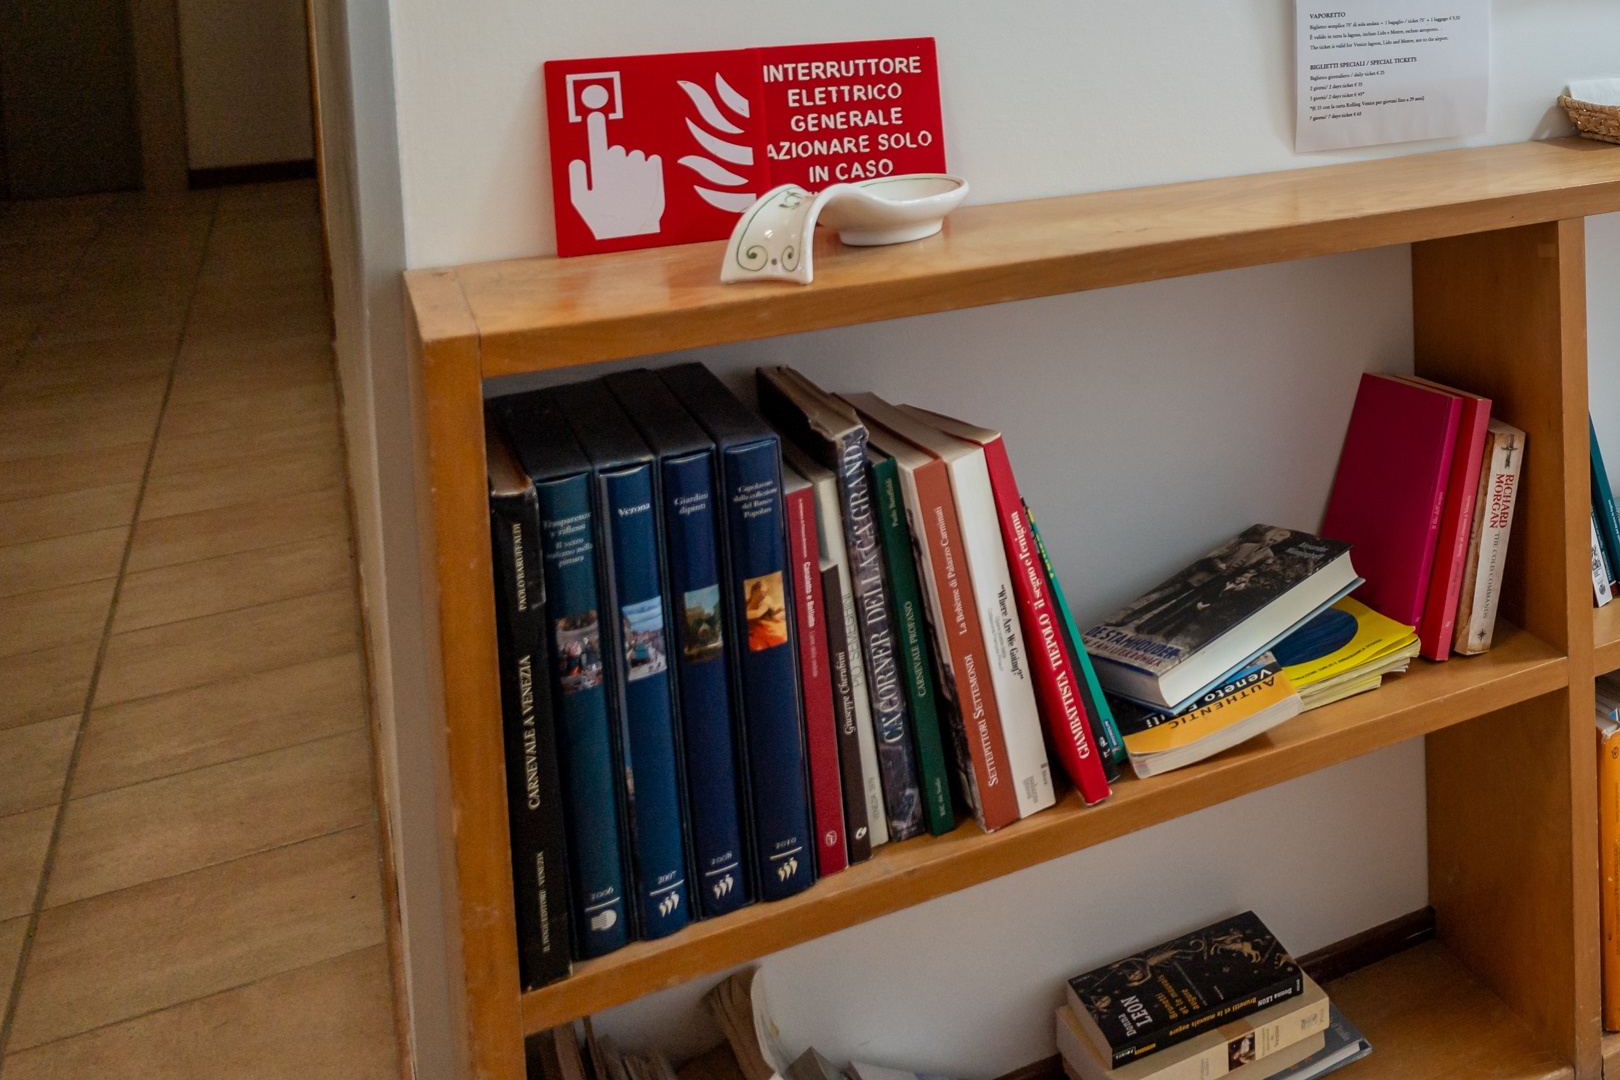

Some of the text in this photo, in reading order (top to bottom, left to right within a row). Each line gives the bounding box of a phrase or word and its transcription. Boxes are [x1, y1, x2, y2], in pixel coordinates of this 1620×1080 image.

[763, 56, 922, 83] INTERRUTTORE
[787, 83, 902, 107] ELETTRICO
[790, 107, 903, 132] GENERALE
[767, 130, 932, 160] AZIONARE SOLO
[809, 158, 894, 183] IN CASO
[617, 503, 650, 518] Verona
[674, 491, 708, 506] Giardini
[679, 502, 706, 516] dipinti
[1489, 474, 1505, 529] MORGAN
[1499, 474, 1515, 528] RICHARD
[1010, 511, 1030, 558] l'enigma
[512, 522, 527, 611] PAOLO BARUFFALDI
[1489, 550, 1498, 572] COLD
[1025, 568, 1044, 601] segno
[1482, 573, 1494, 619] COMMANDS
[1034, 603, 1046, 614] il
[842, 592, 863, 686] PIO SEMEGHINI
[1004, 619, 1014, 633] Are
[1006, 634, 1017, 647] We
[1040, 613, 1062, 670] TIEPOLO
[1086, 626, 1182, 659] DE STAMHOUDER
[904, 601, 927, 697] CARNEVALE PROFANO
[837, 651, 856, 735] Giuseppe Cherubini
[1203, 668, 1272, 702] Veneto
[1057, 672, 1091, 760] GIAMBATTISTA
[1171, 676, 1275, 730] AUTHENTIC
[518, 655, 540, 809] CARNEVALE A VENEZIA
[964, 654, 999, 787] SETTEPITTORI SETTEMONDI
[1118, 1014, 1137, 1037] Donna
[1121, 995, 1153, 1027] LEON
